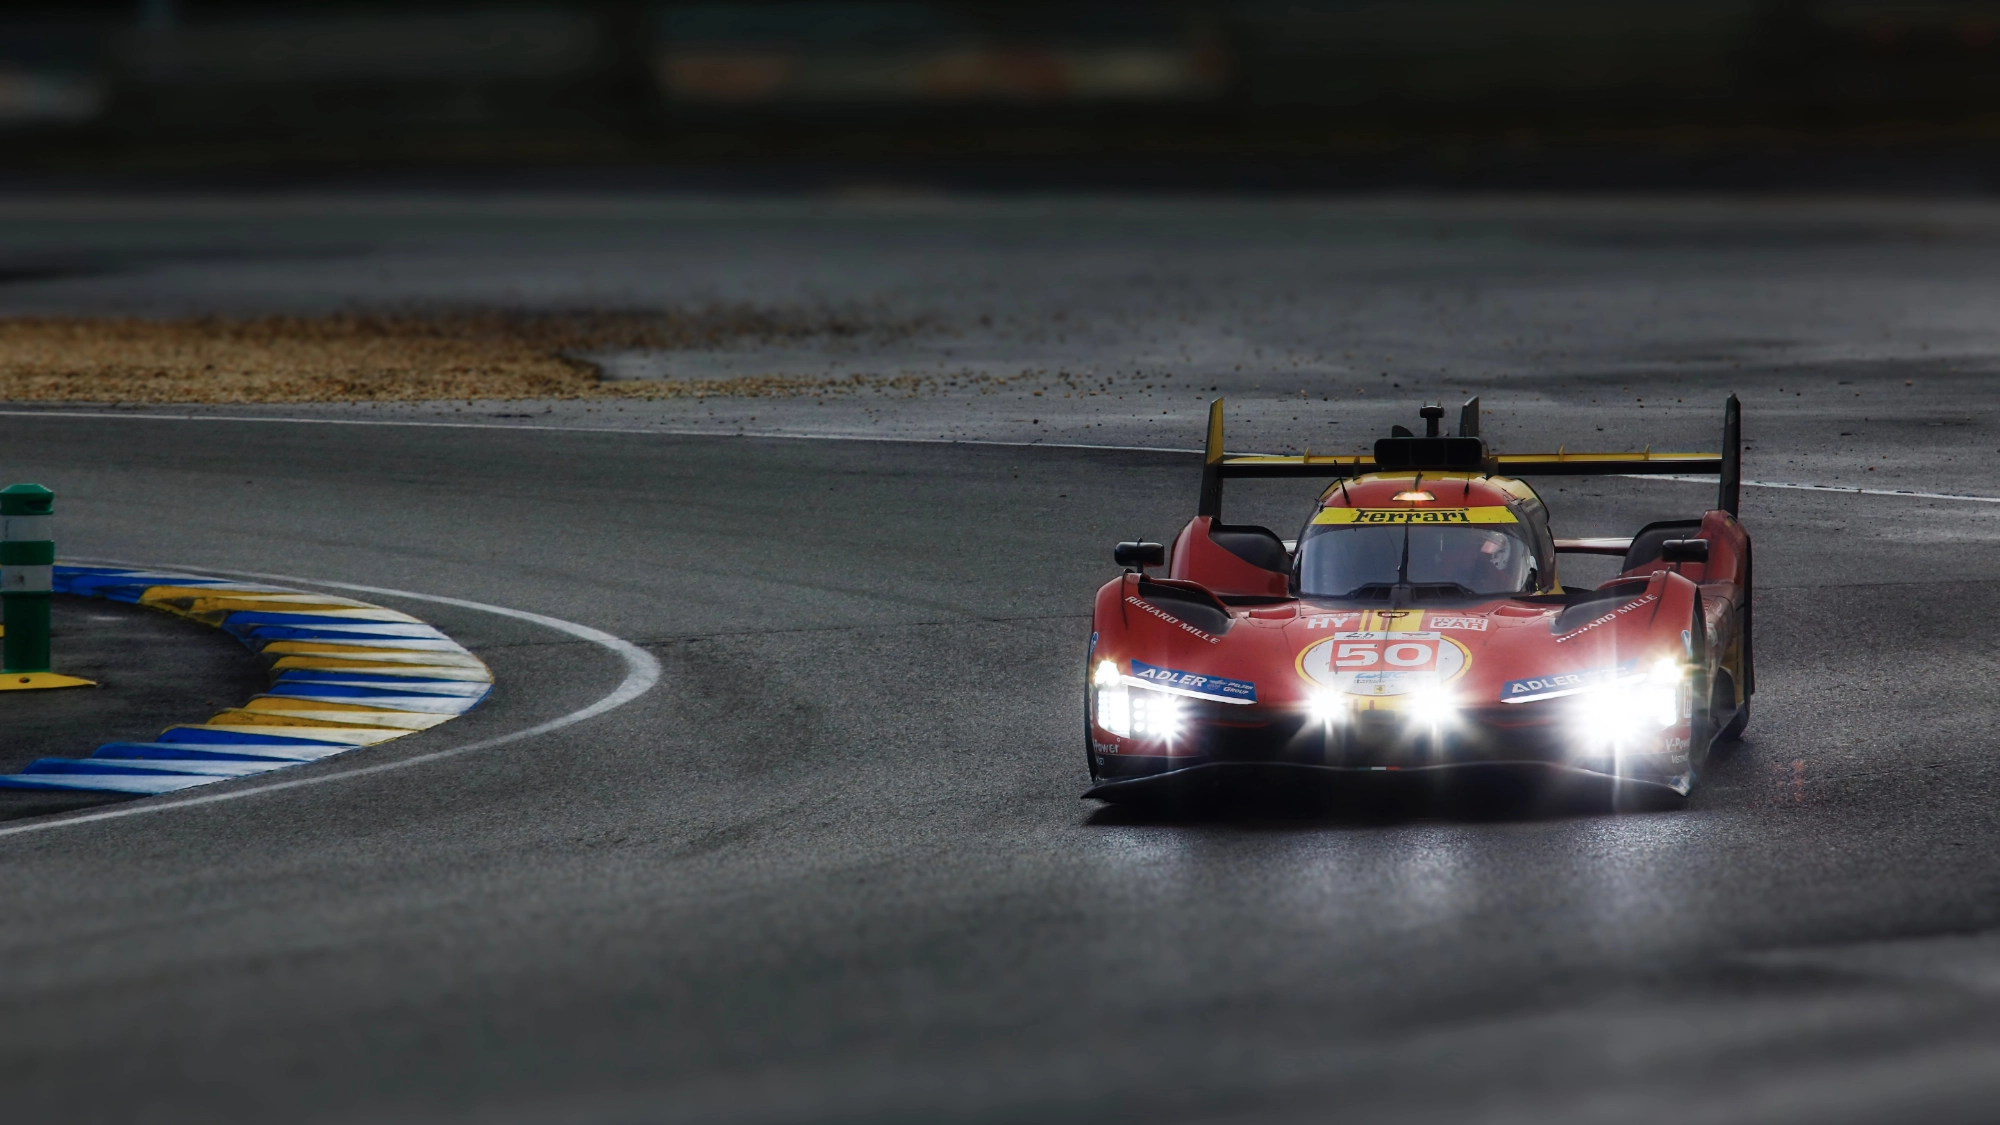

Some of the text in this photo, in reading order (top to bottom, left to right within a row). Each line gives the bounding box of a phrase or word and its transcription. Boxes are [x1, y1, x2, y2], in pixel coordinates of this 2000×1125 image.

[1351, 508, 1470, 523] Ferrari
[1617, 594, 1658, 614] MILLE
[1125, 596, 1221, 645] RICHARD MILLE
[1307, 617, 1349, 629] HY
[1433, 621, 1484, 630] CAR
[1335, 643, 1433, 667] 50
[1137, 668, 1208, 687] ADLER
[1511, 674, 1583, 694] ADLER
